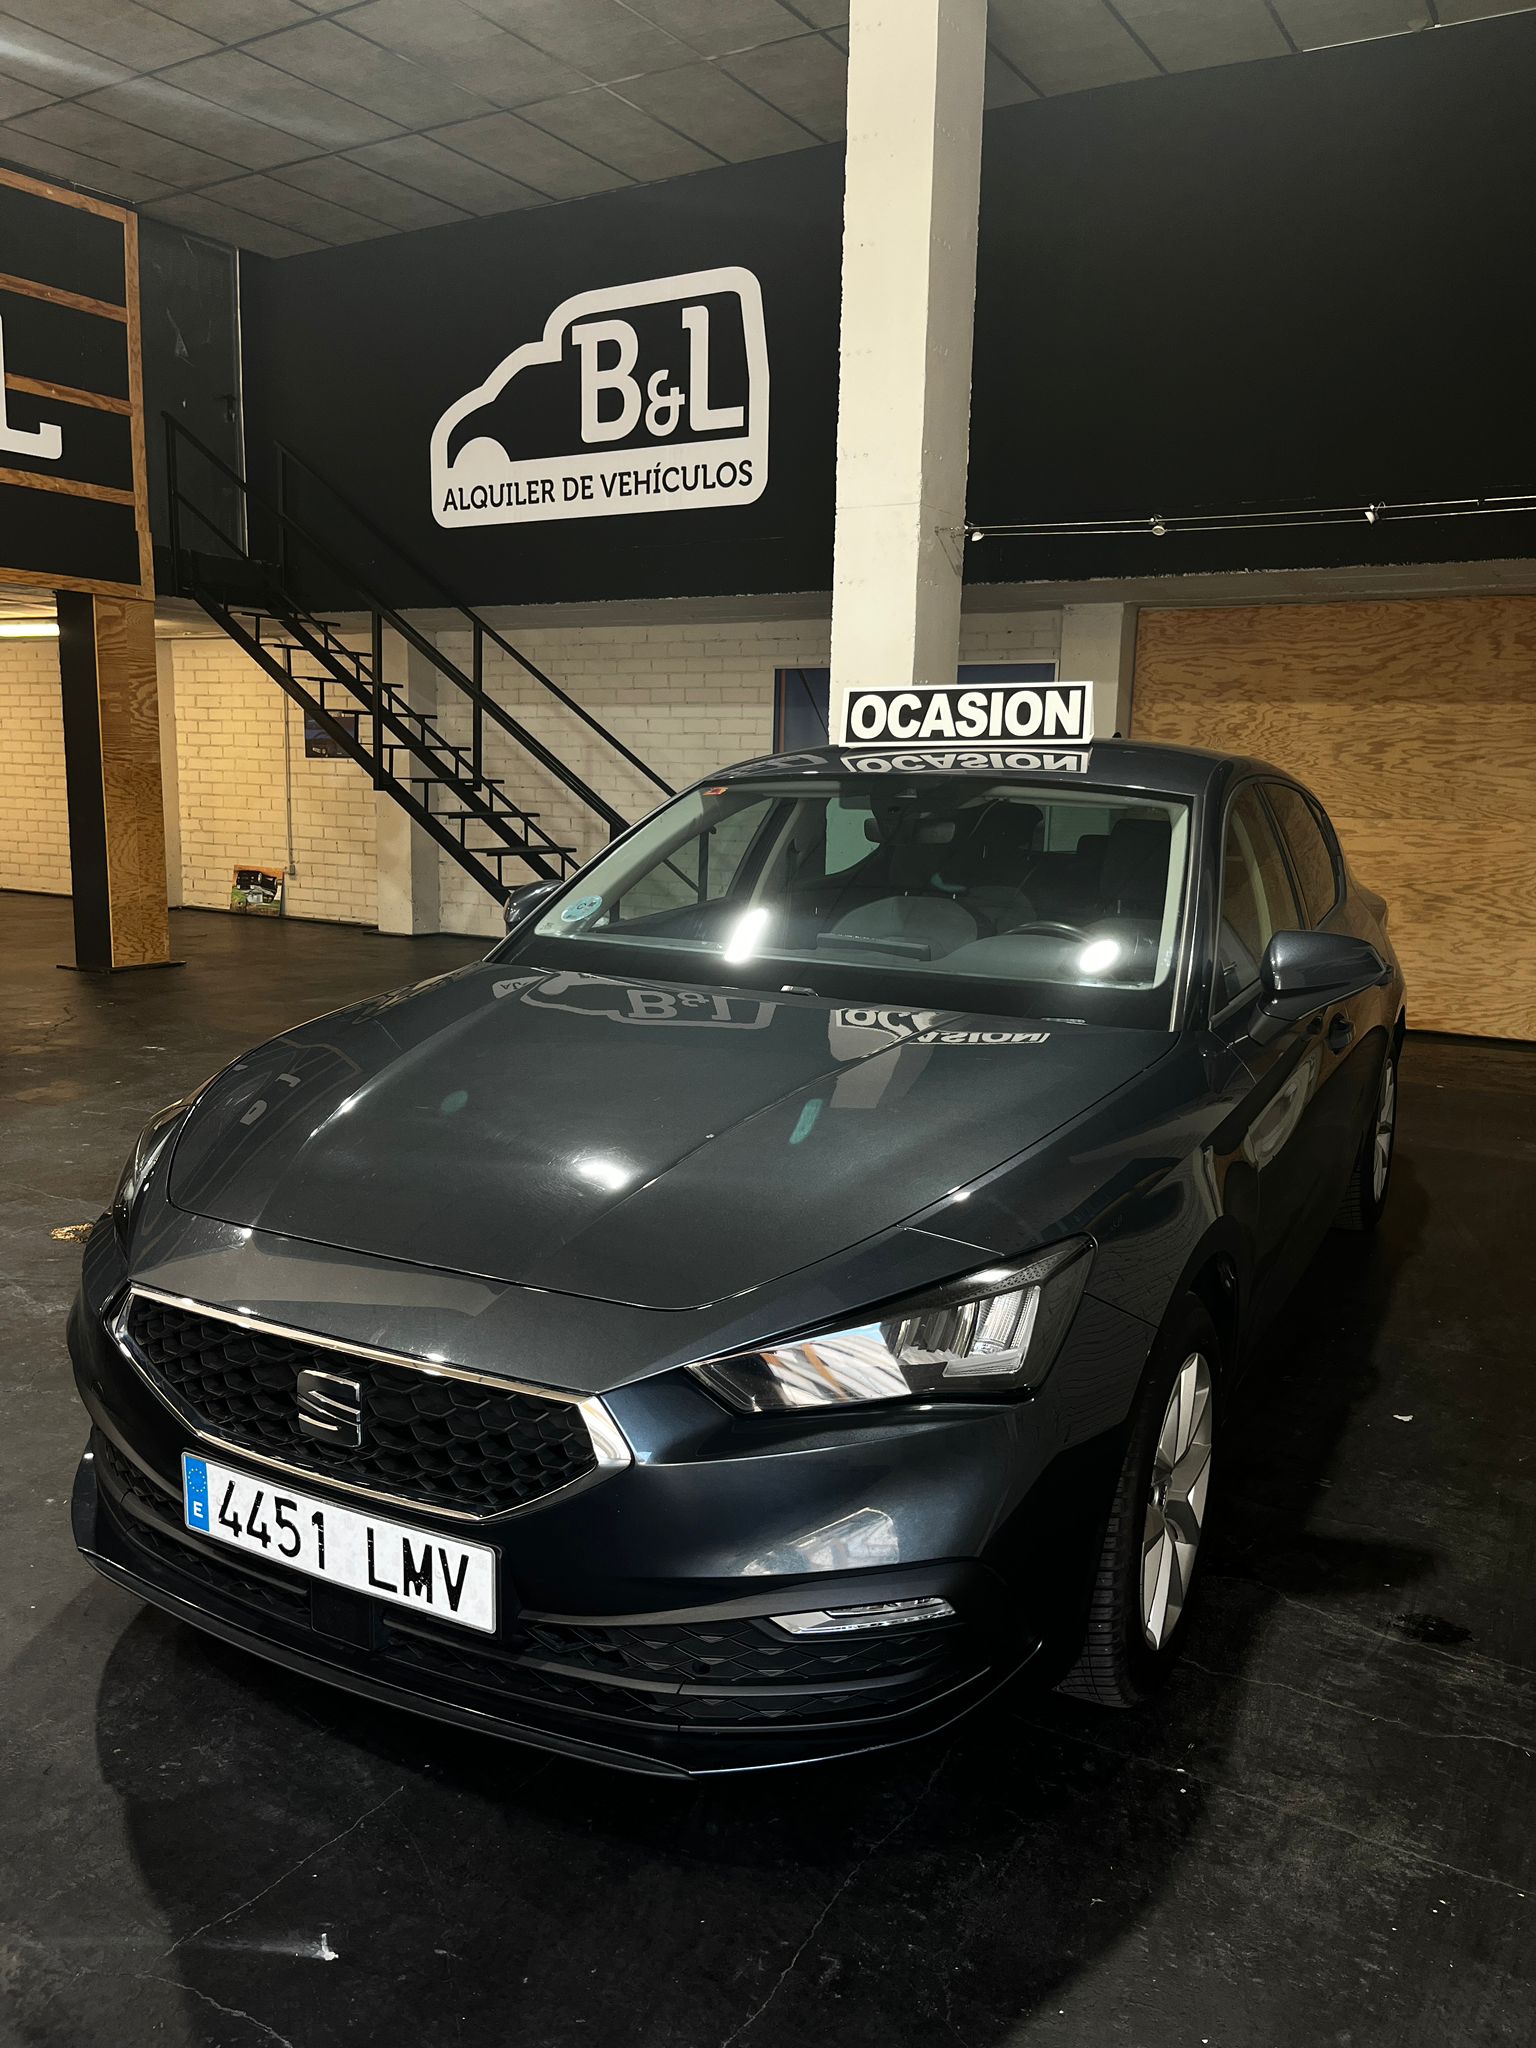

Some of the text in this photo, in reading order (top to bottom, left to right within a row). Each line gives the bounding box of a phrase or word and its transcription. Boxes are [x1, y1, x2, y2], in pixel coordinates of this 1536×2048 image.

[571, 305, 744, 443] B&L
[442, 459, 753, 511] ALQUILER DE VEHÍCULOS
[850, 690, 1082, 739] OCASION
[193, 1500, 203, 1519] E
[218, 1480, 470, 1612] 4451 LMV
